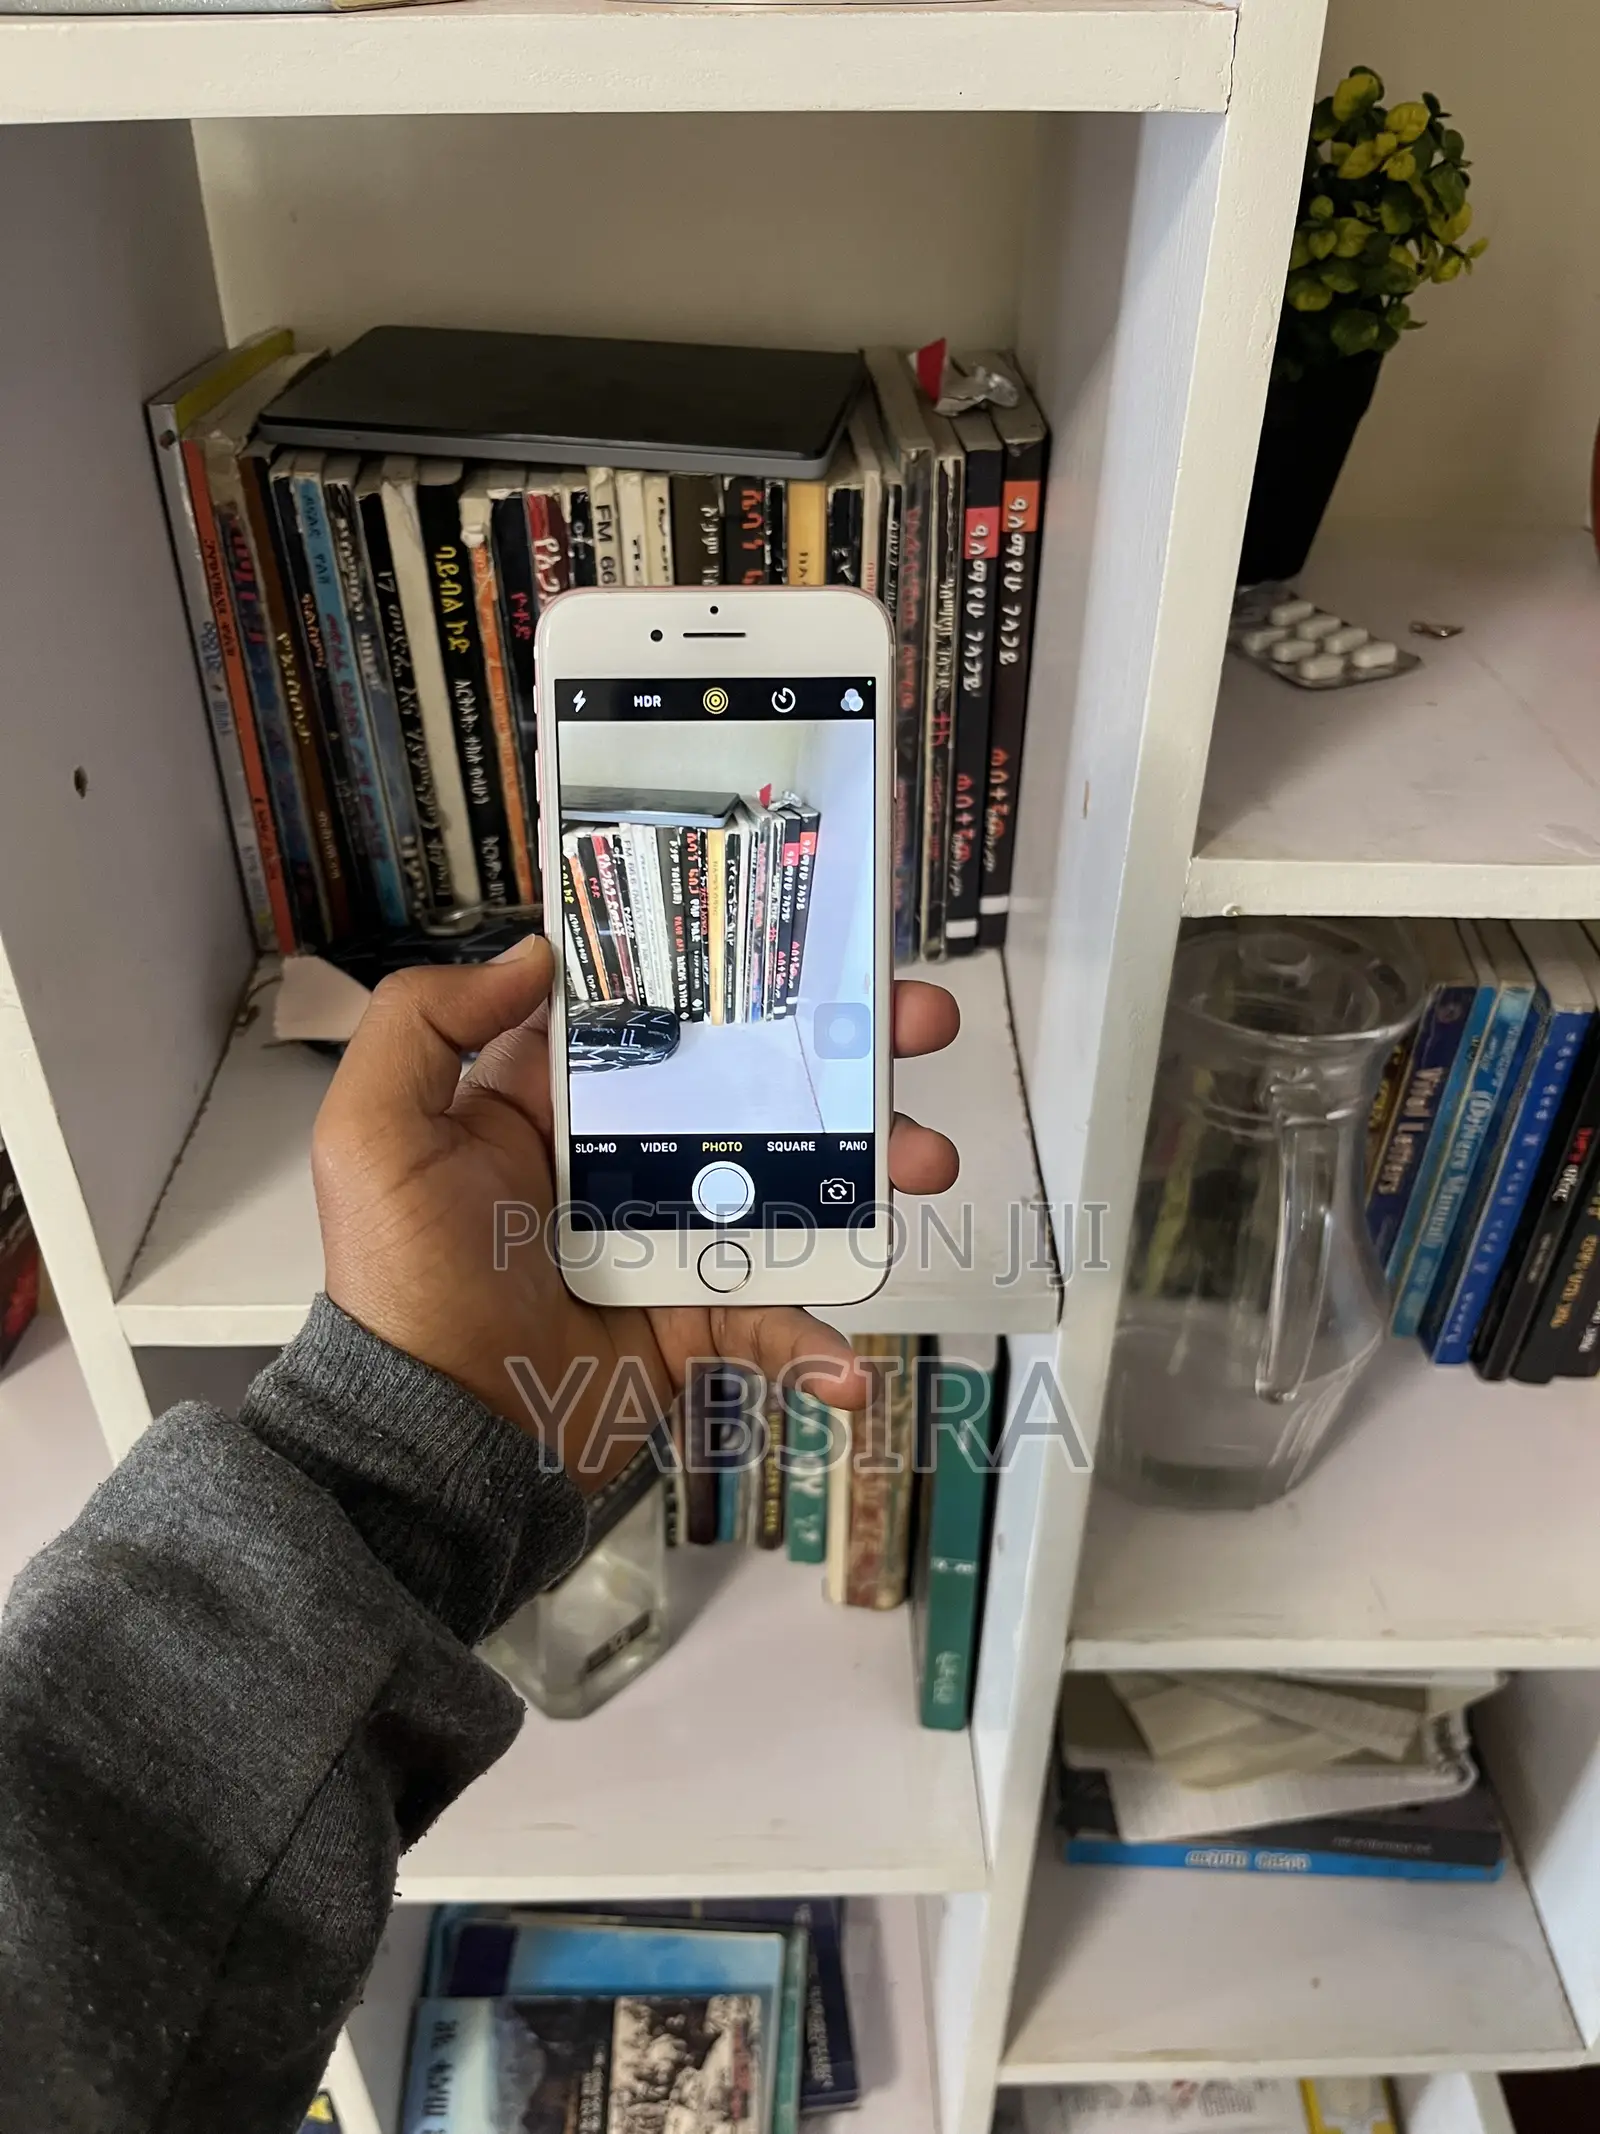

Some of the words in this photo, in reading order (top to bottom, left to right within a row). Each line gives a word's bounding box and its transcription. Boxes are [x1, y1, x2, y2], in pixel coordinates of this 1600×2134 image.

[595, 503, 614, 543] FM
[600, 555, 617, 586] 66
[434, 545, 464, 614] ባይብል
[445, 619, 471, 654] ኮድ
[633, 694, 662, 709] HDR
[575, 1142, 617, 1154] SLO-MO
[640, 1142, 678, 1153] VIDEO
[702, 1140, 743, 1152] PHOTO
[766, 1140, 816, 1152] SQUARE
[839, 1140, 868, 1151] PANO
